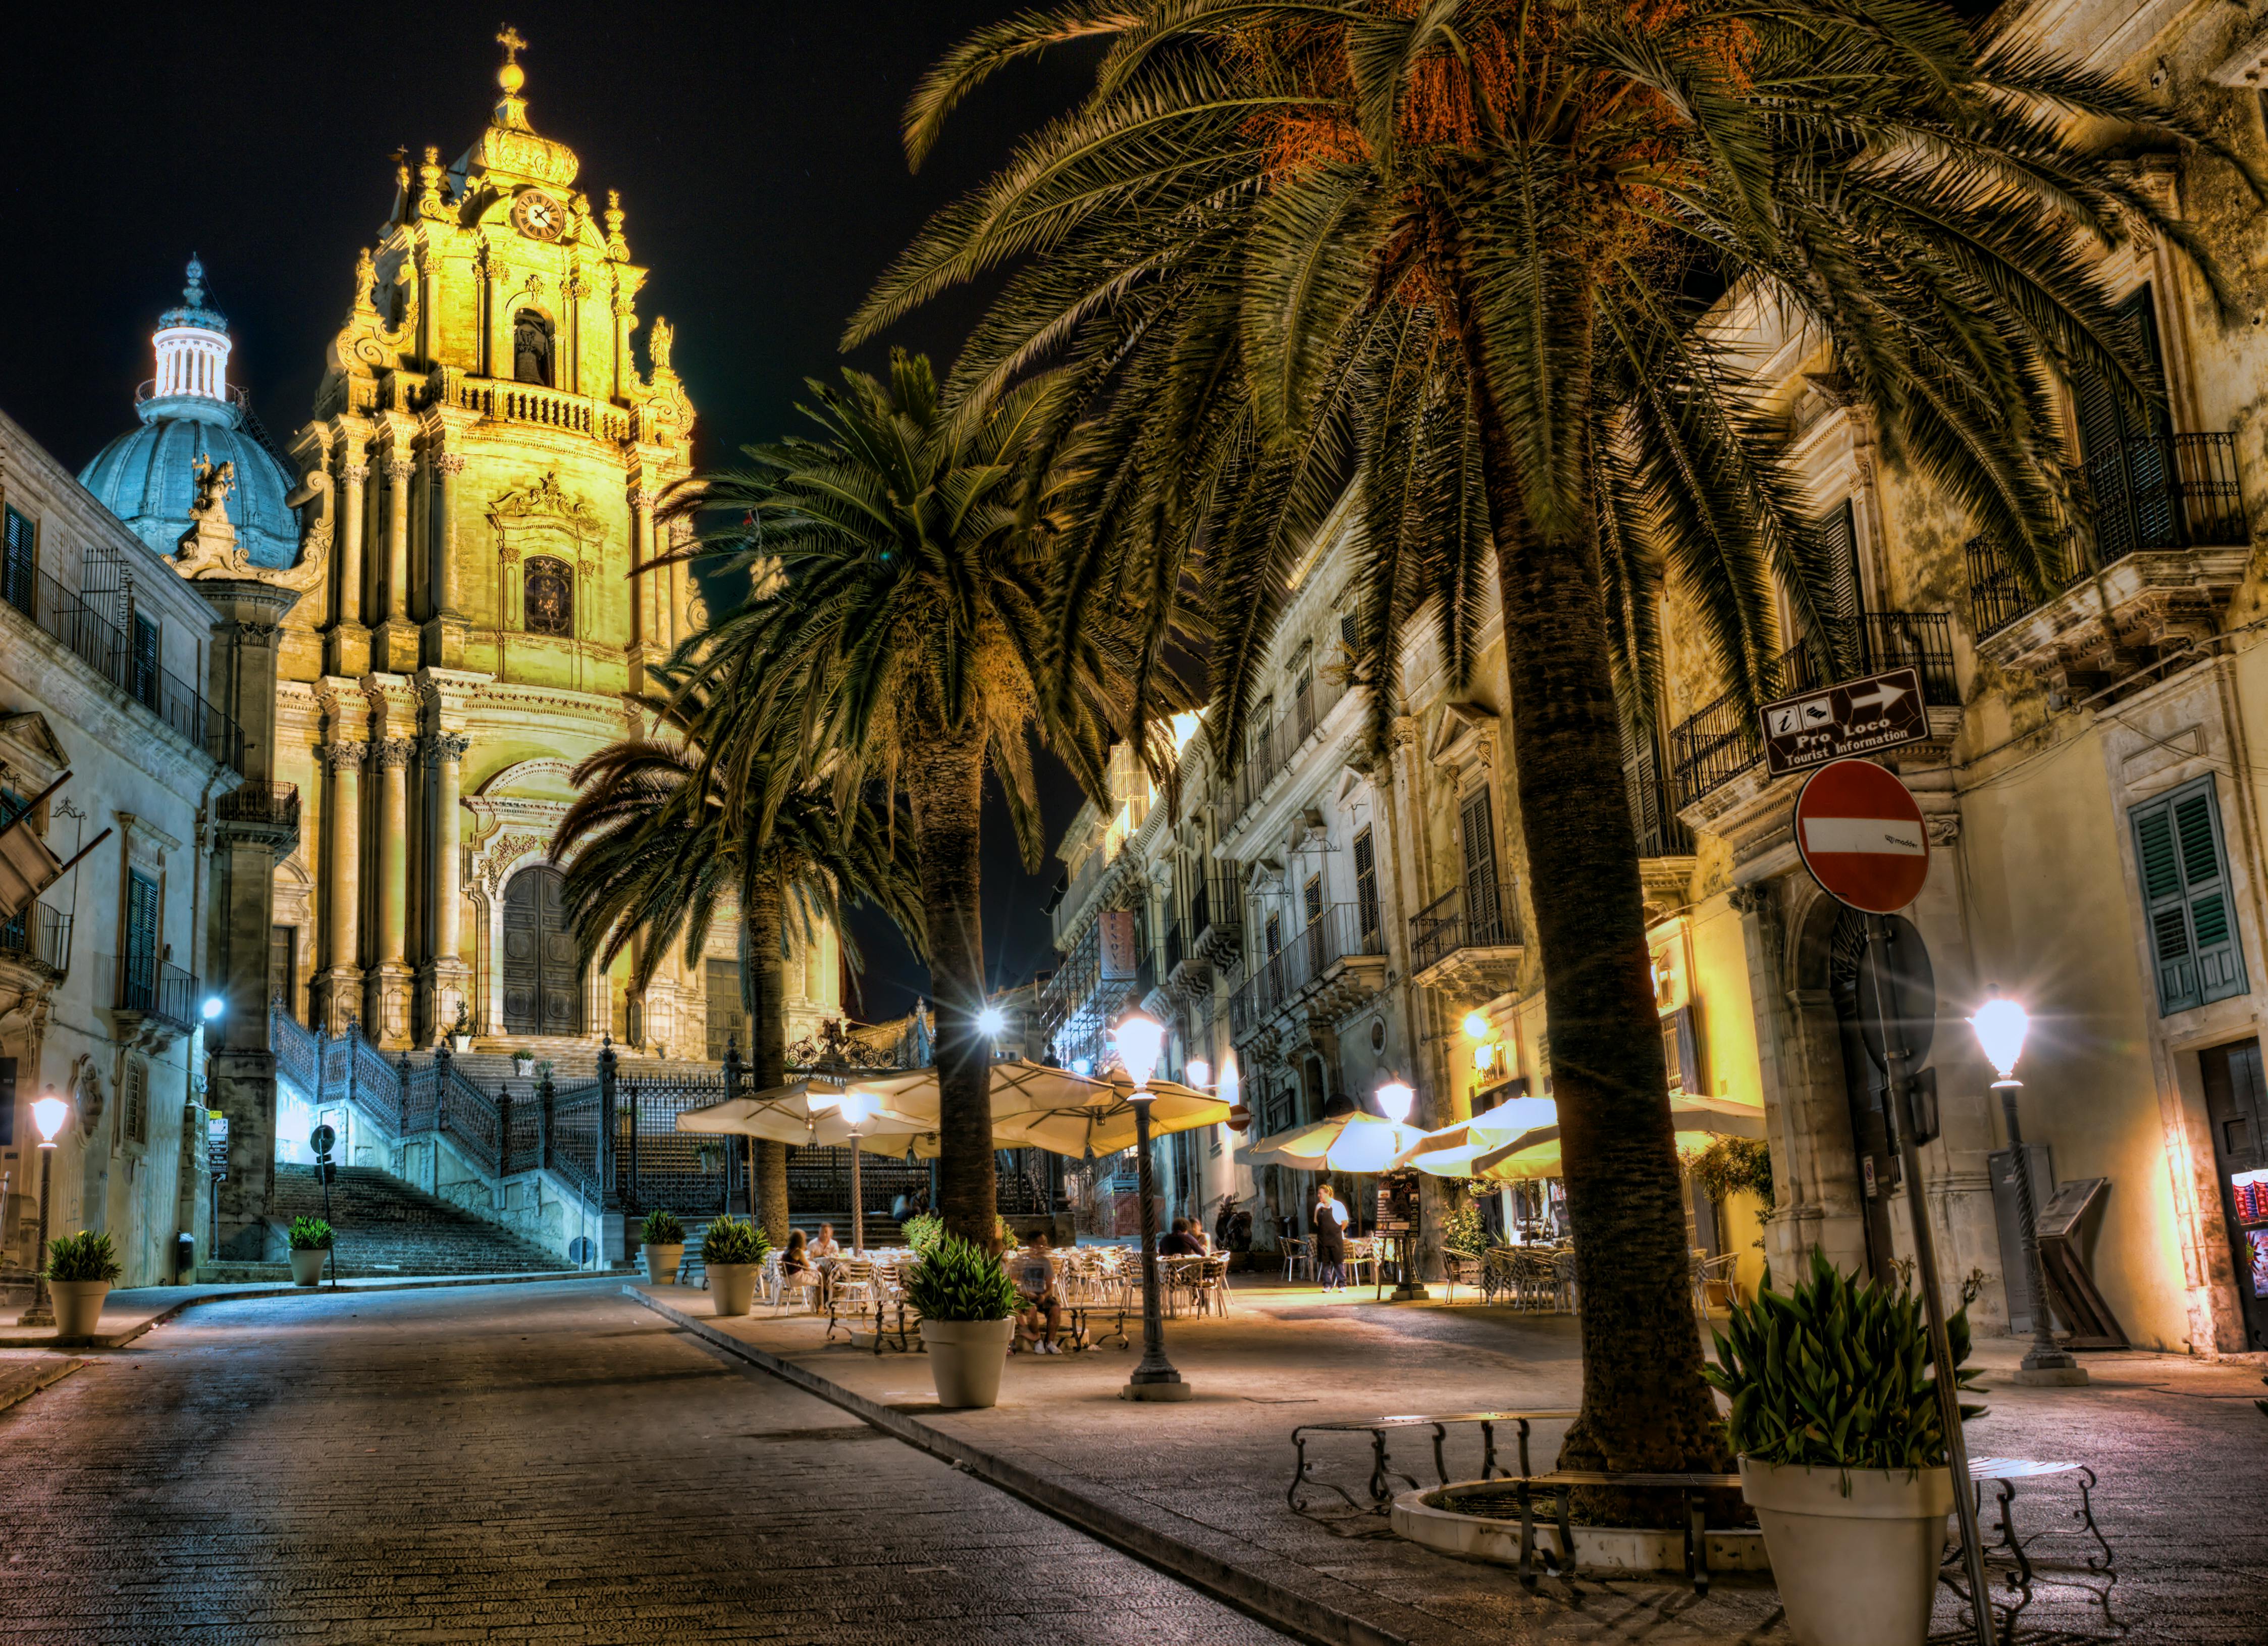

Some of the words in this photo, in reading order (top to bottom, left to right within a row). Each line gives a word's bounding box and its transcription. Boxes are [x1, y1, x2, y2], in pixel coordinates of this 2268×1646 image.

[1786, 748, 1829, 766] Tourist
[1835, 730, 1908, 754] Information
[1797, 733, 1831, 748] Pro
[1843, 718, 1890, 737] Loco
